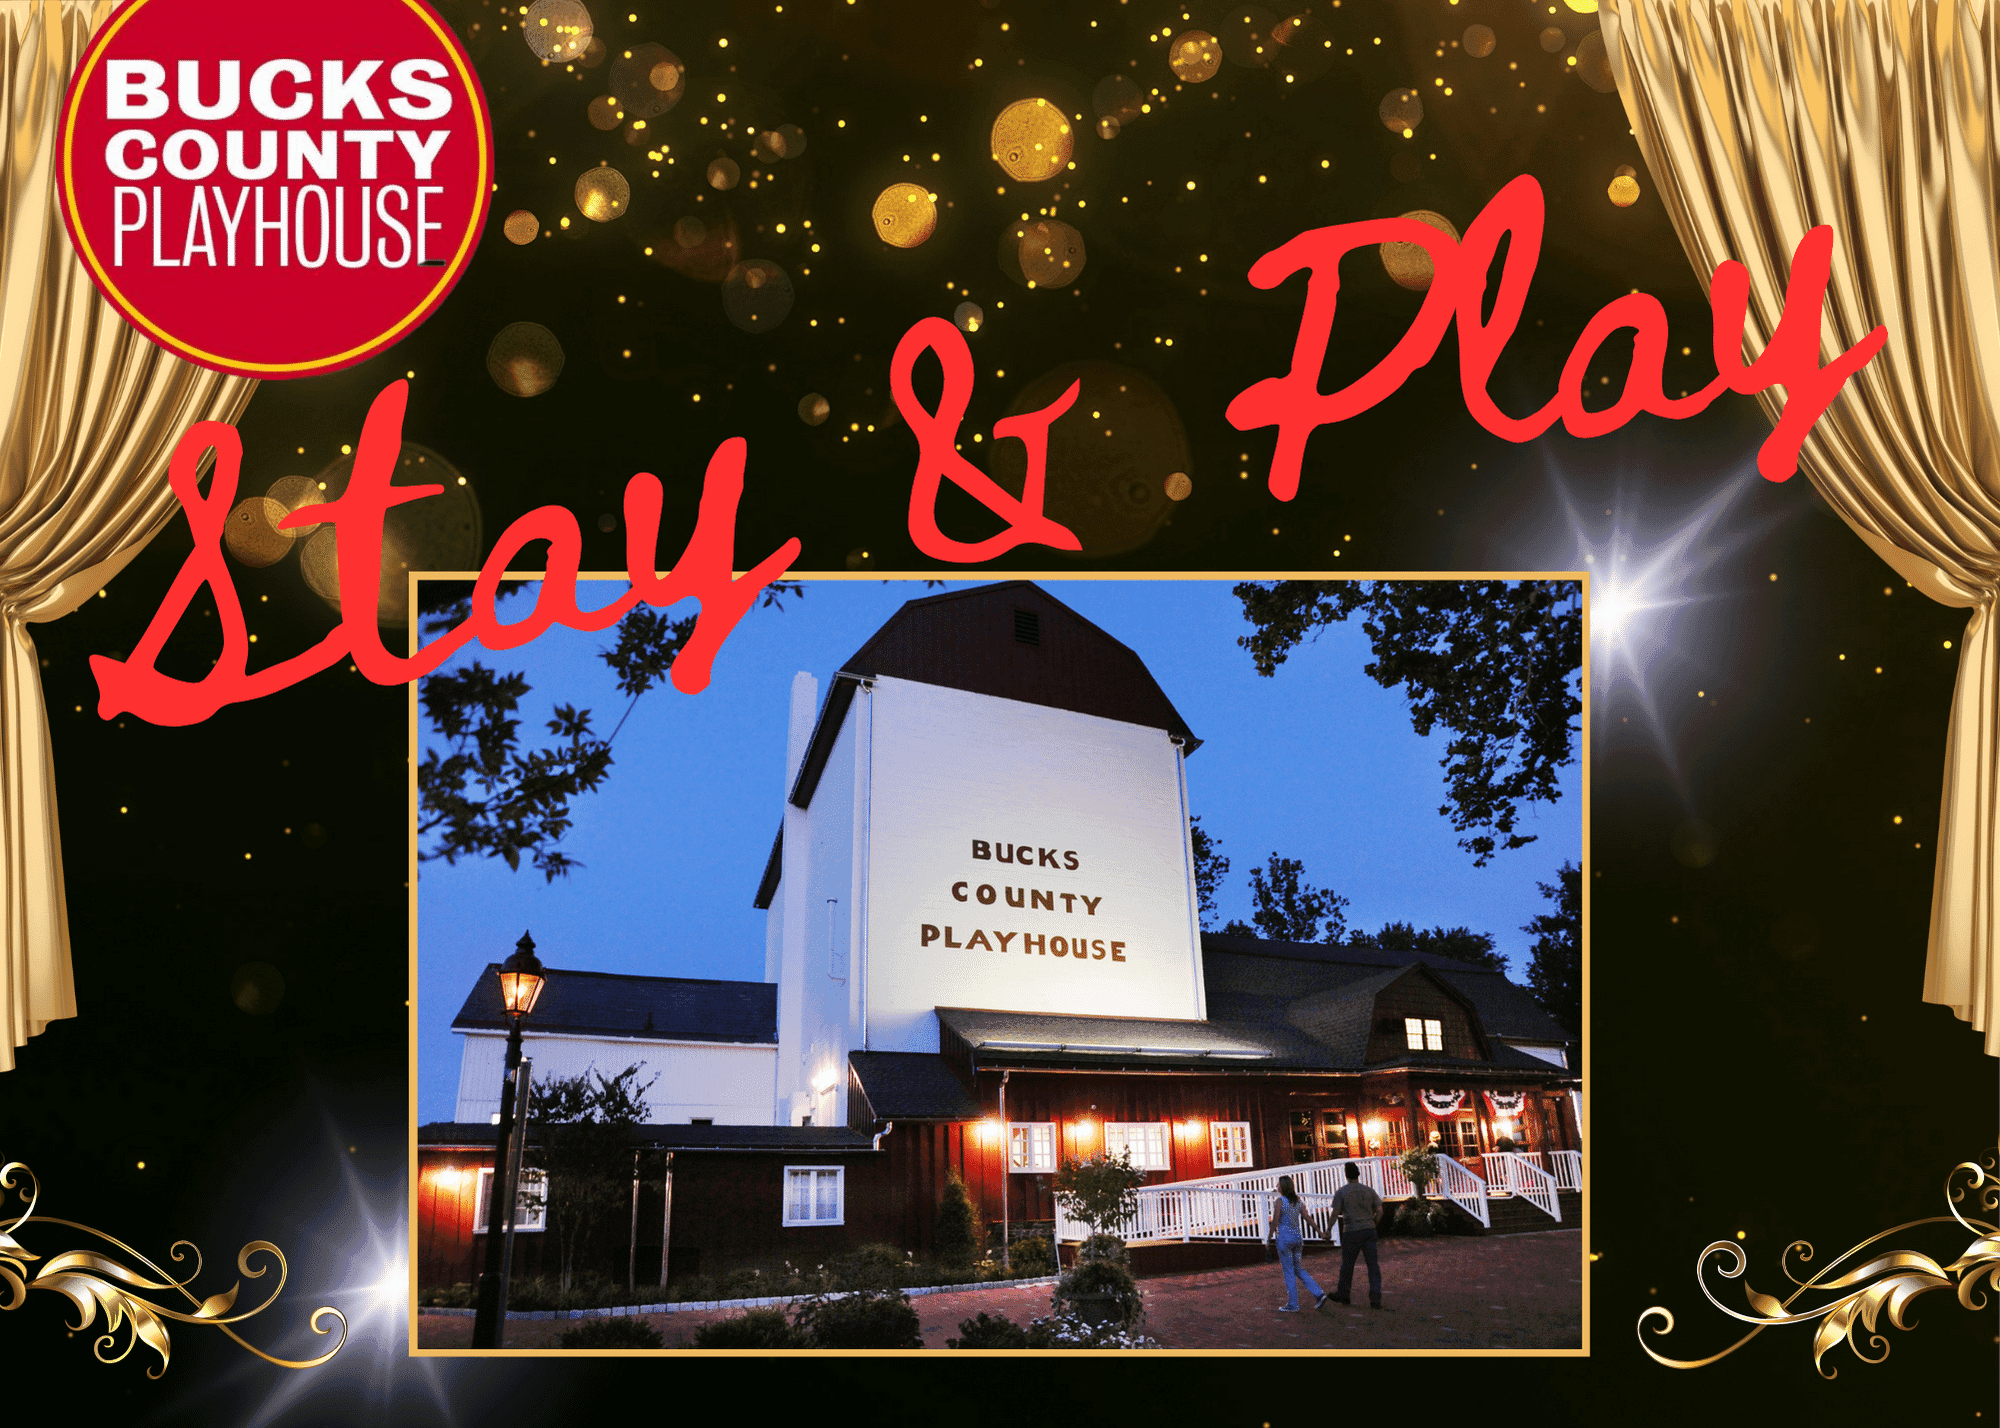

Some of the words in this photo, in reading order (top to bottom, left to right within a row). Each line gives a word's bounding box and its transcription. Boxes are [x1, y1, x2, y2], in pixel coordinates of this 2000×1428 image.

[971, 838, 1080, 872] BUCKS
[951, 880, 1102, 917] COUNTY
[920, 923, 1128, 963] PLAYHOUSE
